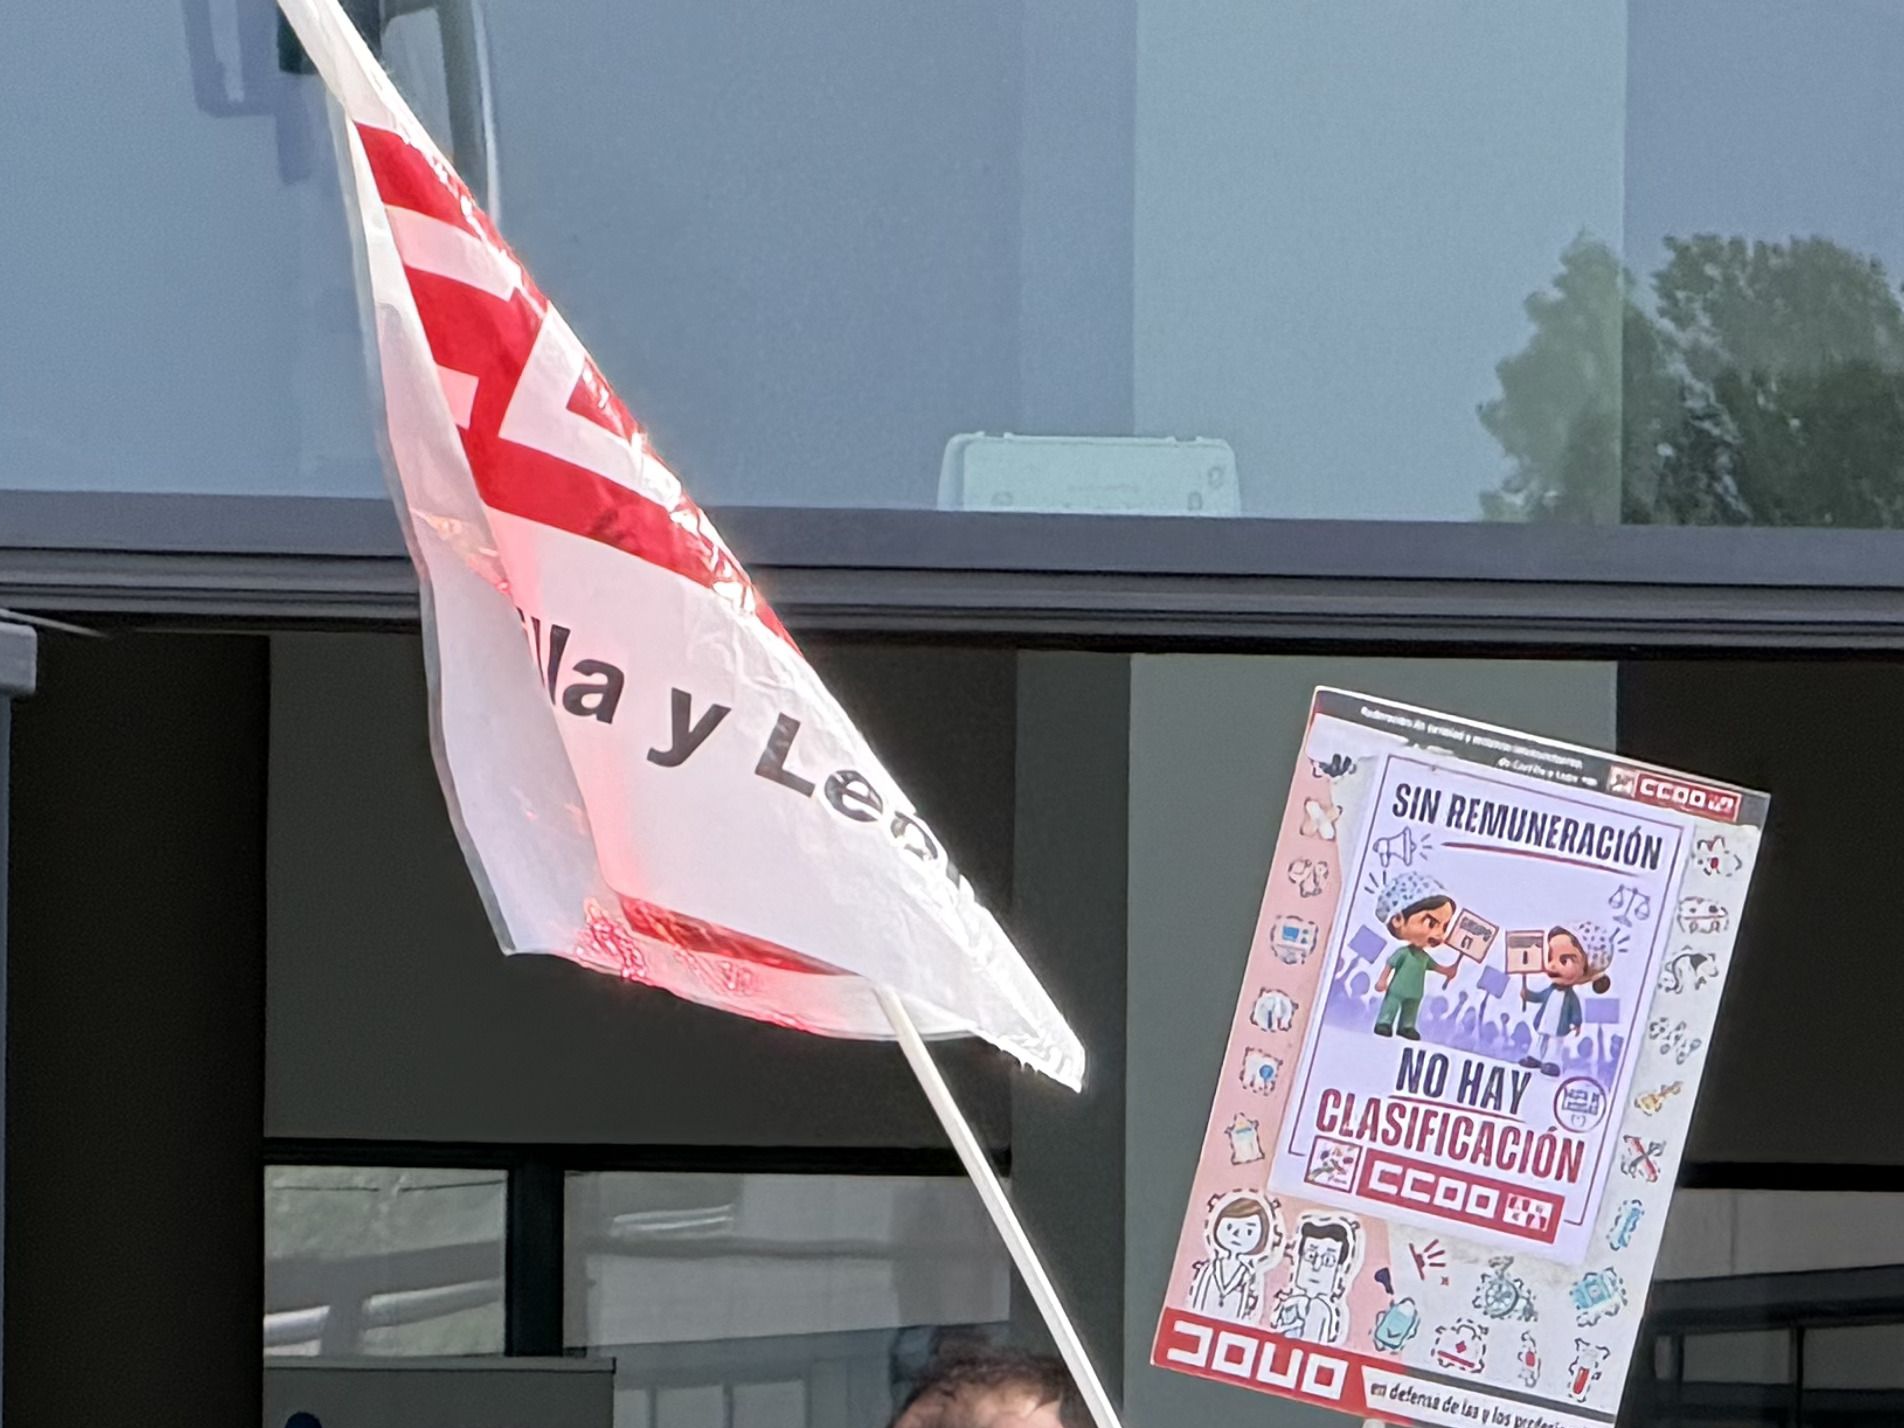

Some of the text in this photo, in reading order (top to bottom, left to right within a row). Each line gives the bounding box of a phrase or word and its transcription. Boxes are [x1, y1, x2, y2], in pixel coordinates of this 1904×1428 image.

[646, 687, 732, 767] y
[1392, 782, 1664, 872] SIN REMUNERACIÓN
[1396, 1047, 1450, 1098] NO
[1457, 1059, 1532, 1115] HAY
[1316, 1088, 1585, 1185] CLASIFICACIÓN
[1369, 1161, 1500, 1220] CCOO
[1389, 1384, 1440, 1411] defensa
[1442, 1397, 1459, 1415] de
[1492, 1407, 1511, 1427] los
